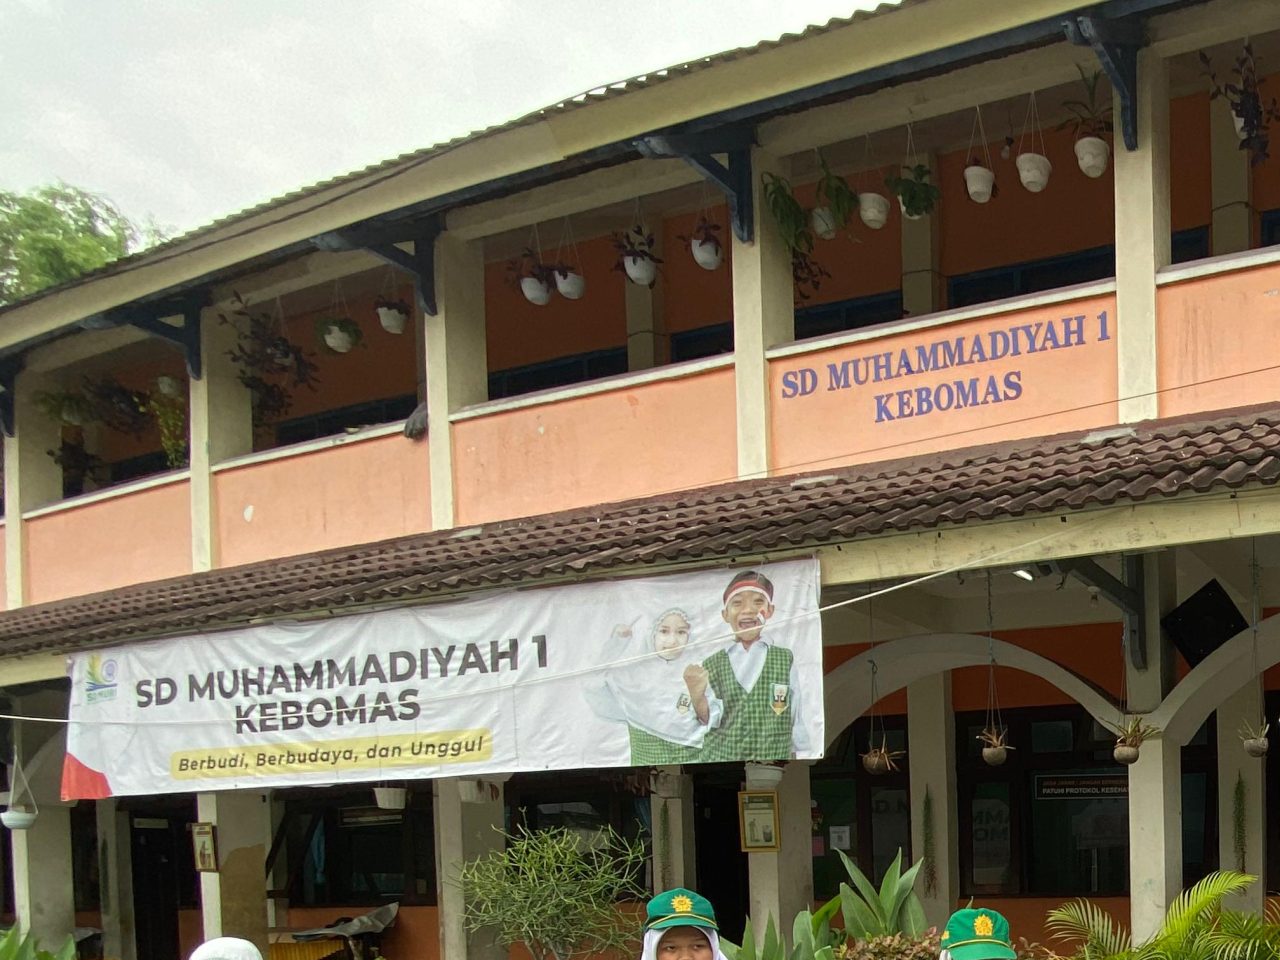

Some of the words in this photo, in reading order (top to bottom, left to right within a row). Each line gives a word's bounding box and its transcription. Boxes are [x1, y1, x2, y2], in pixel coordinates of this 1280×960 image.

[781, 368, 818, 399] SD
[827, 315, 1086, 391] MUHAMMADIYAH
[1096, 311, 1111, 342] 1
[874, 371, 1023, 423] KEBOMAS
[136, 677, 178, 708] SD
[188, 638, 518, 702] MUHAMMADIYAH
[532, 634, 548, 668] 1
[235, 688, 421, 734] KEBOMAS
[178, 755, 249, 772] Berbudi,
[255, 747, 359, 767] Berbudaya,
[366, 744, 402, 759] dan
[410, 735, 484, 757] Unggul
